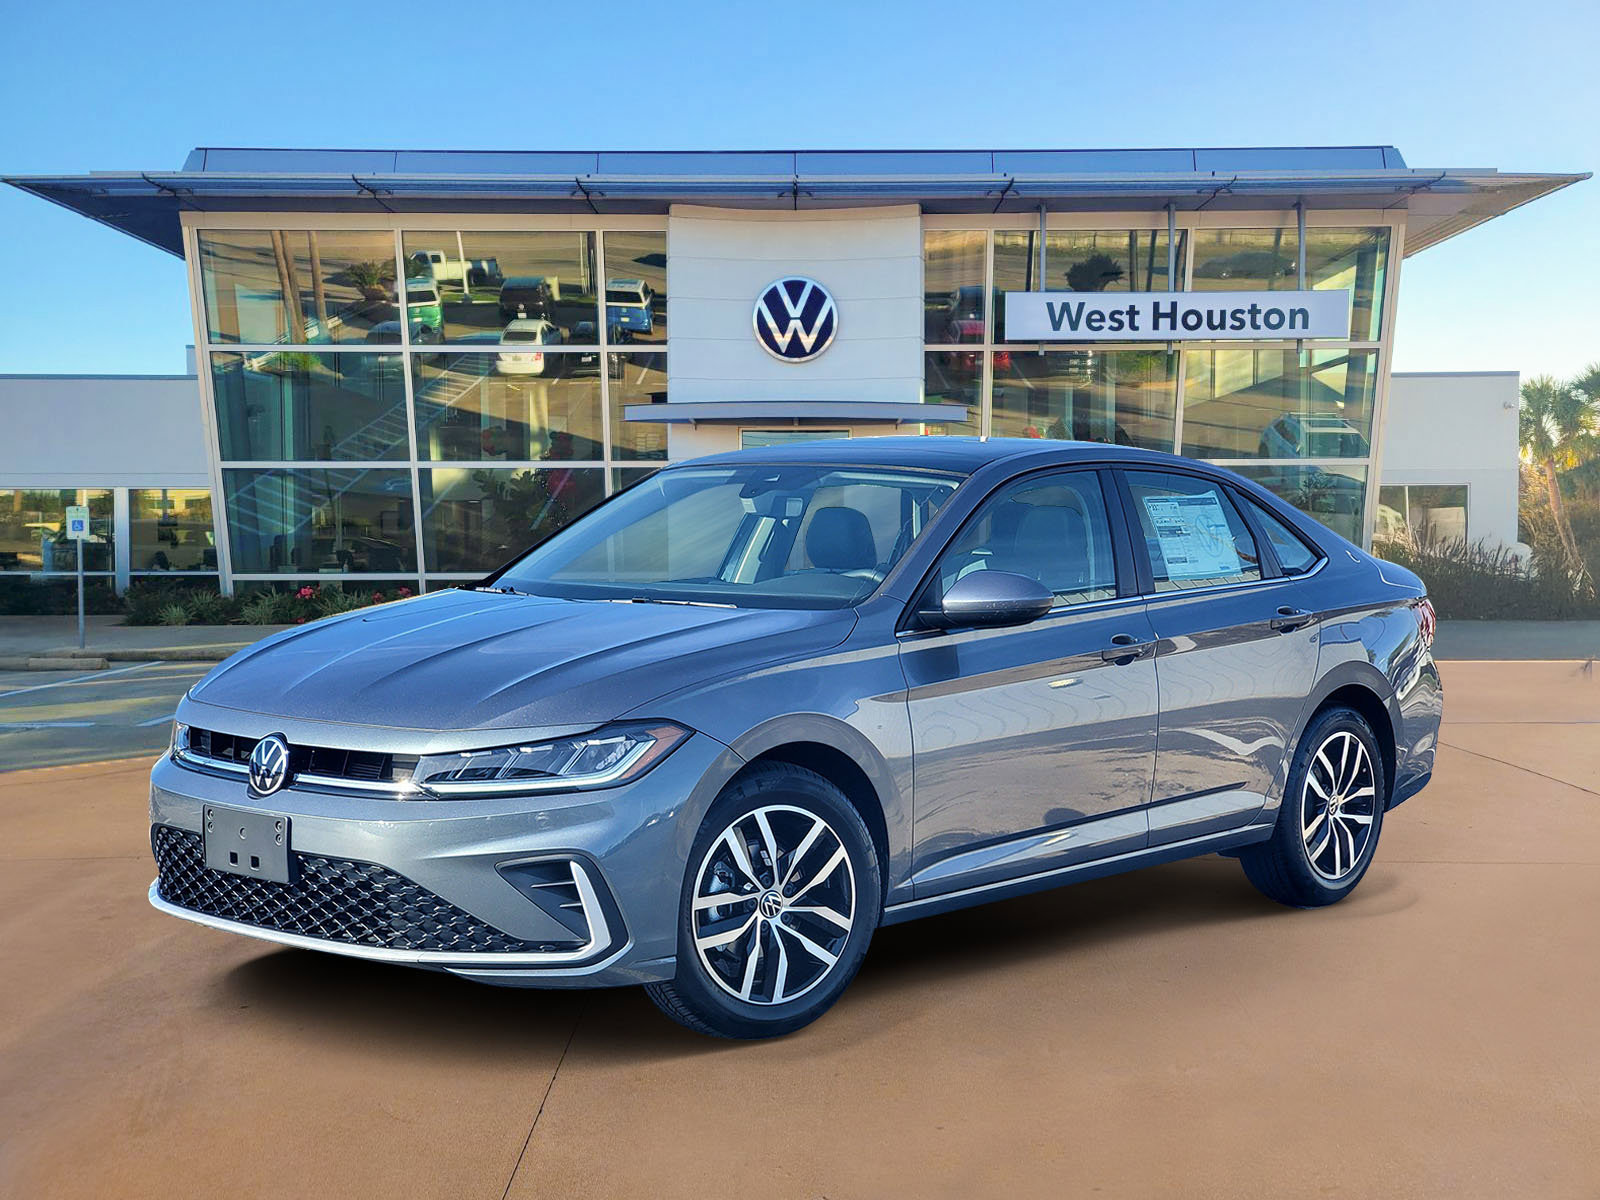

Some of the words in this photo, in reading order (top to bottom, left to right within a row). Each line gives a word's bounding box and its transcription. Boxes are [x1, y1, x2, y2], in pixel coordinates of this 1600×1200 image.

[755, 277, 836, 359] VW
[1046, 301, 1140, 332] West
[1152, 301, 1309, 331] Houston
[250, 737, 287, 794] VW
